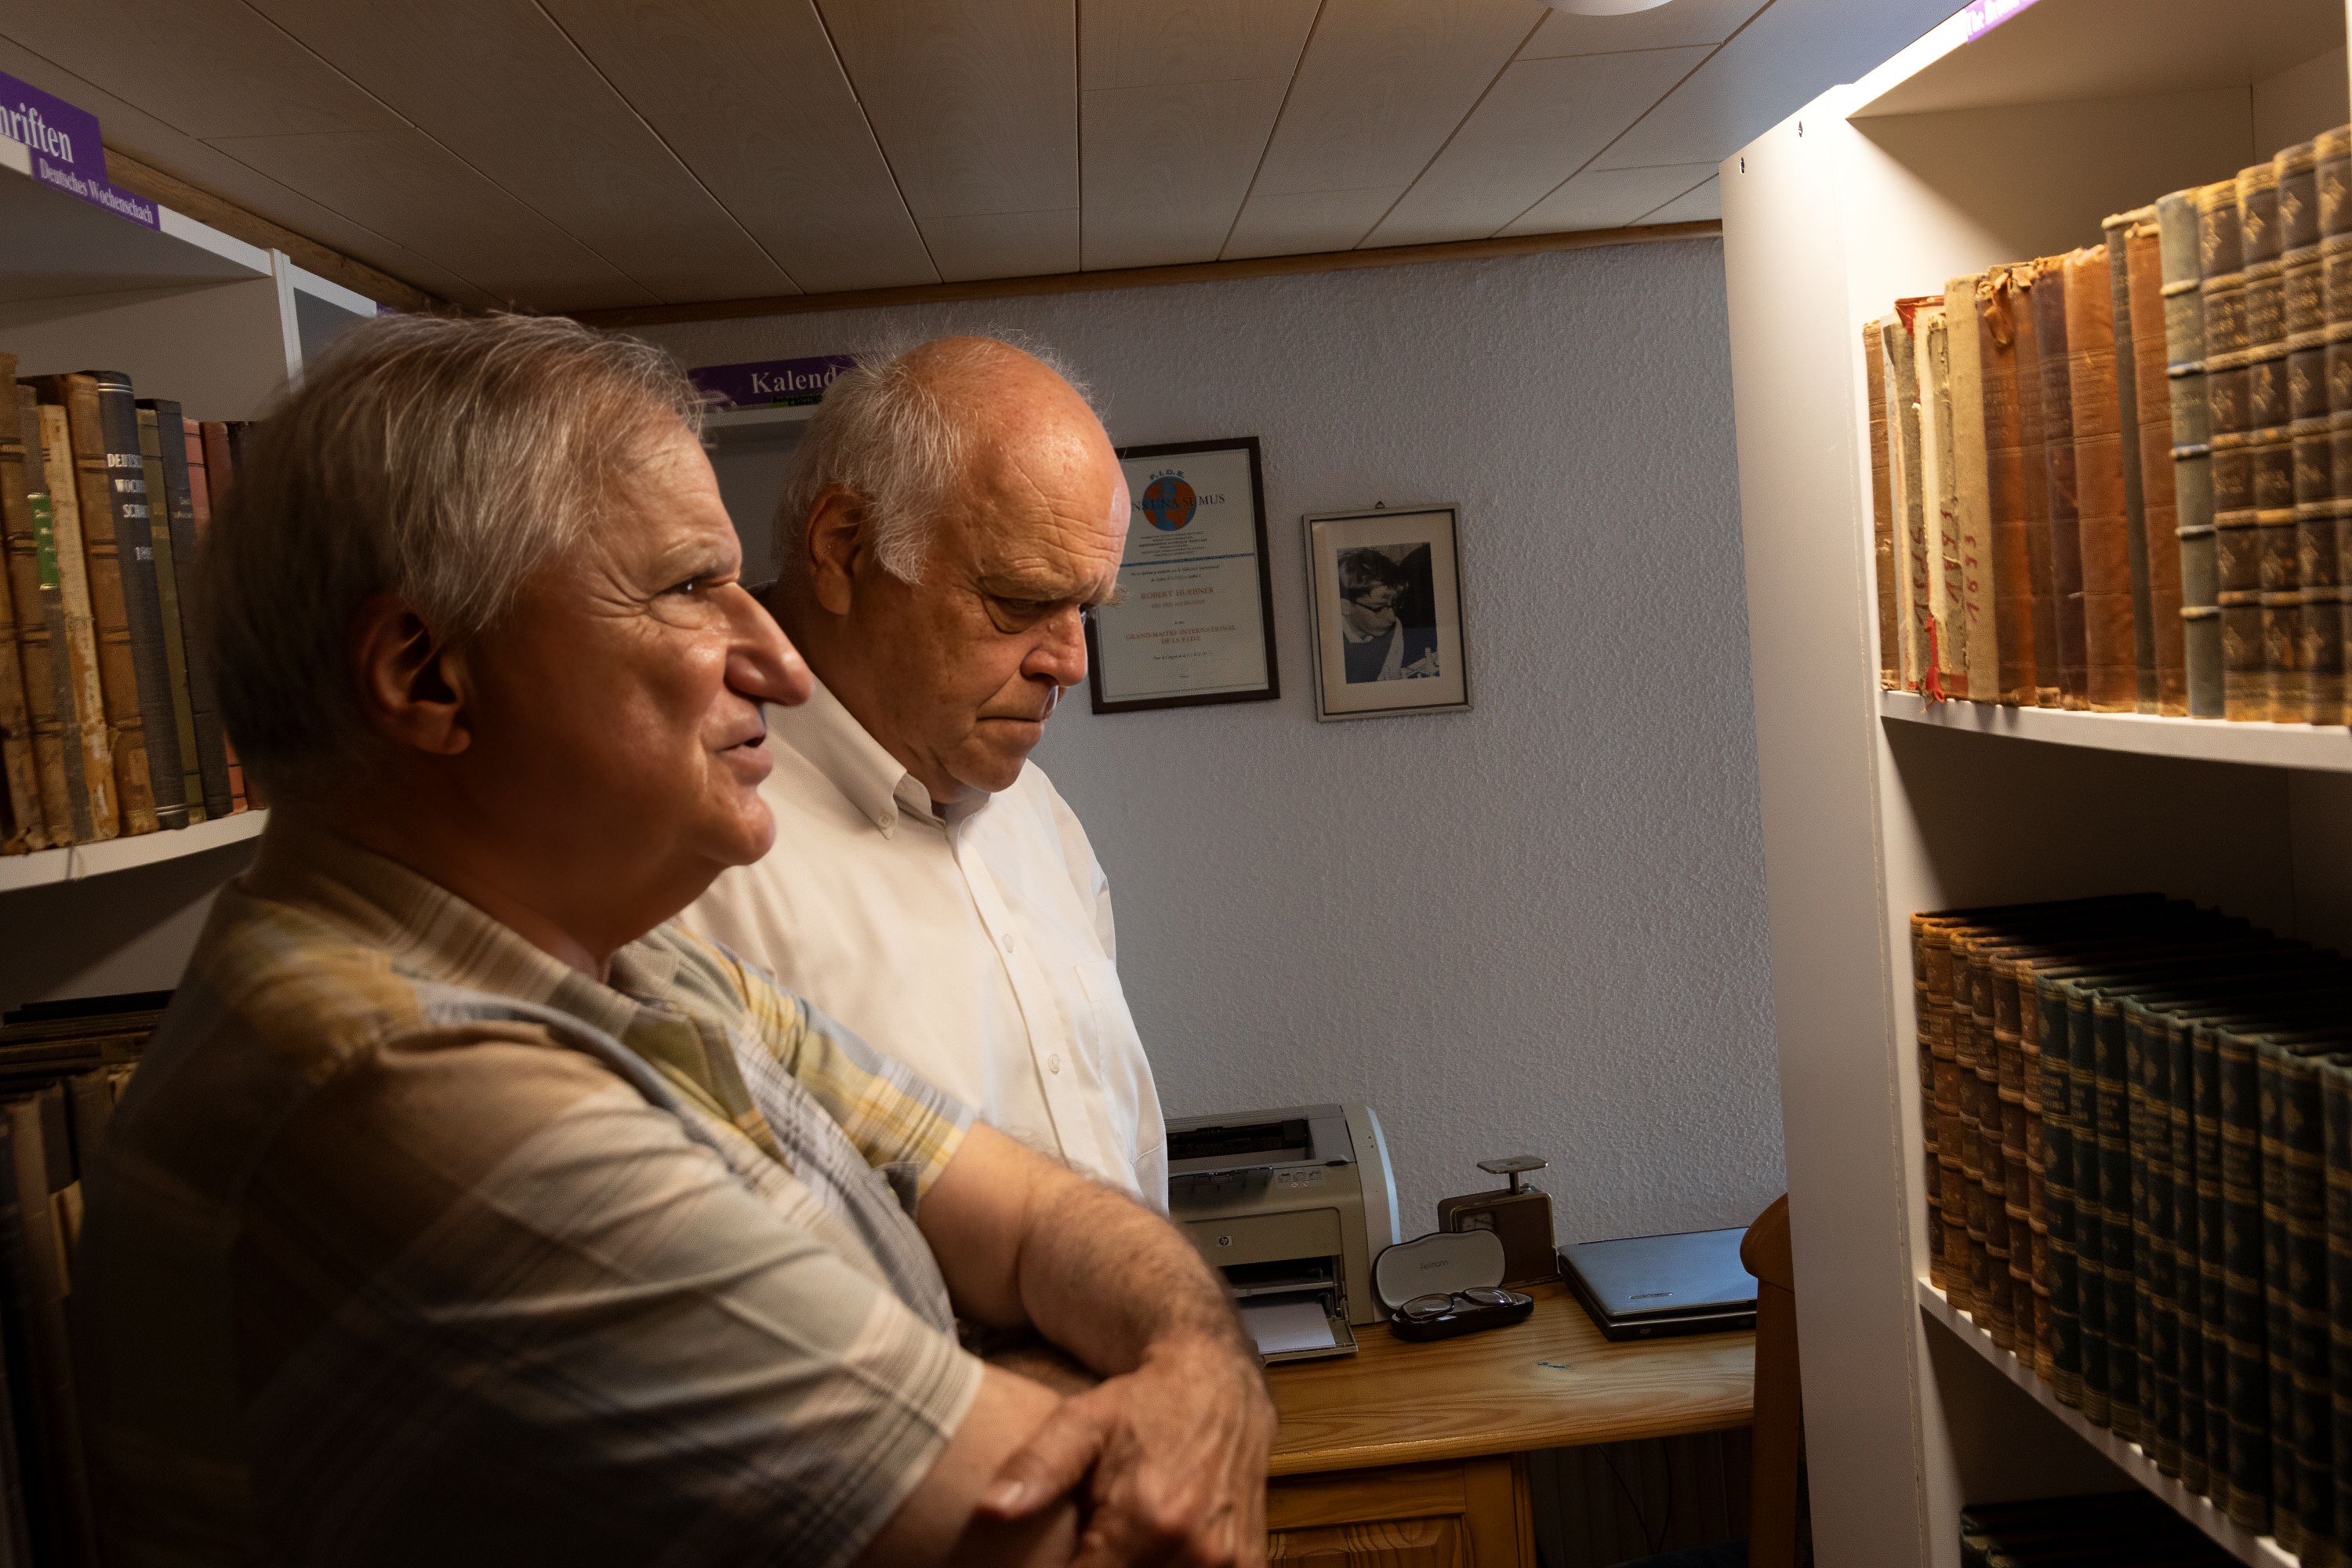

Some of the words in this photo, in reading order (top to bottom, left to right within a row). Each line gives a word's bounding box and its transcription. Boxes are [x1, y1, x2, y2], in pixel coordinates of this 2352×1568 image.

[39, 158, 88, 196] Deutsches
[88, 179, 154, 223] Wochenschach
[750, 365, 837, 394] Kalend
[1182, 494, 1225, 509] SUMUS
[1141, 590, 1174, 600] ROBERT
